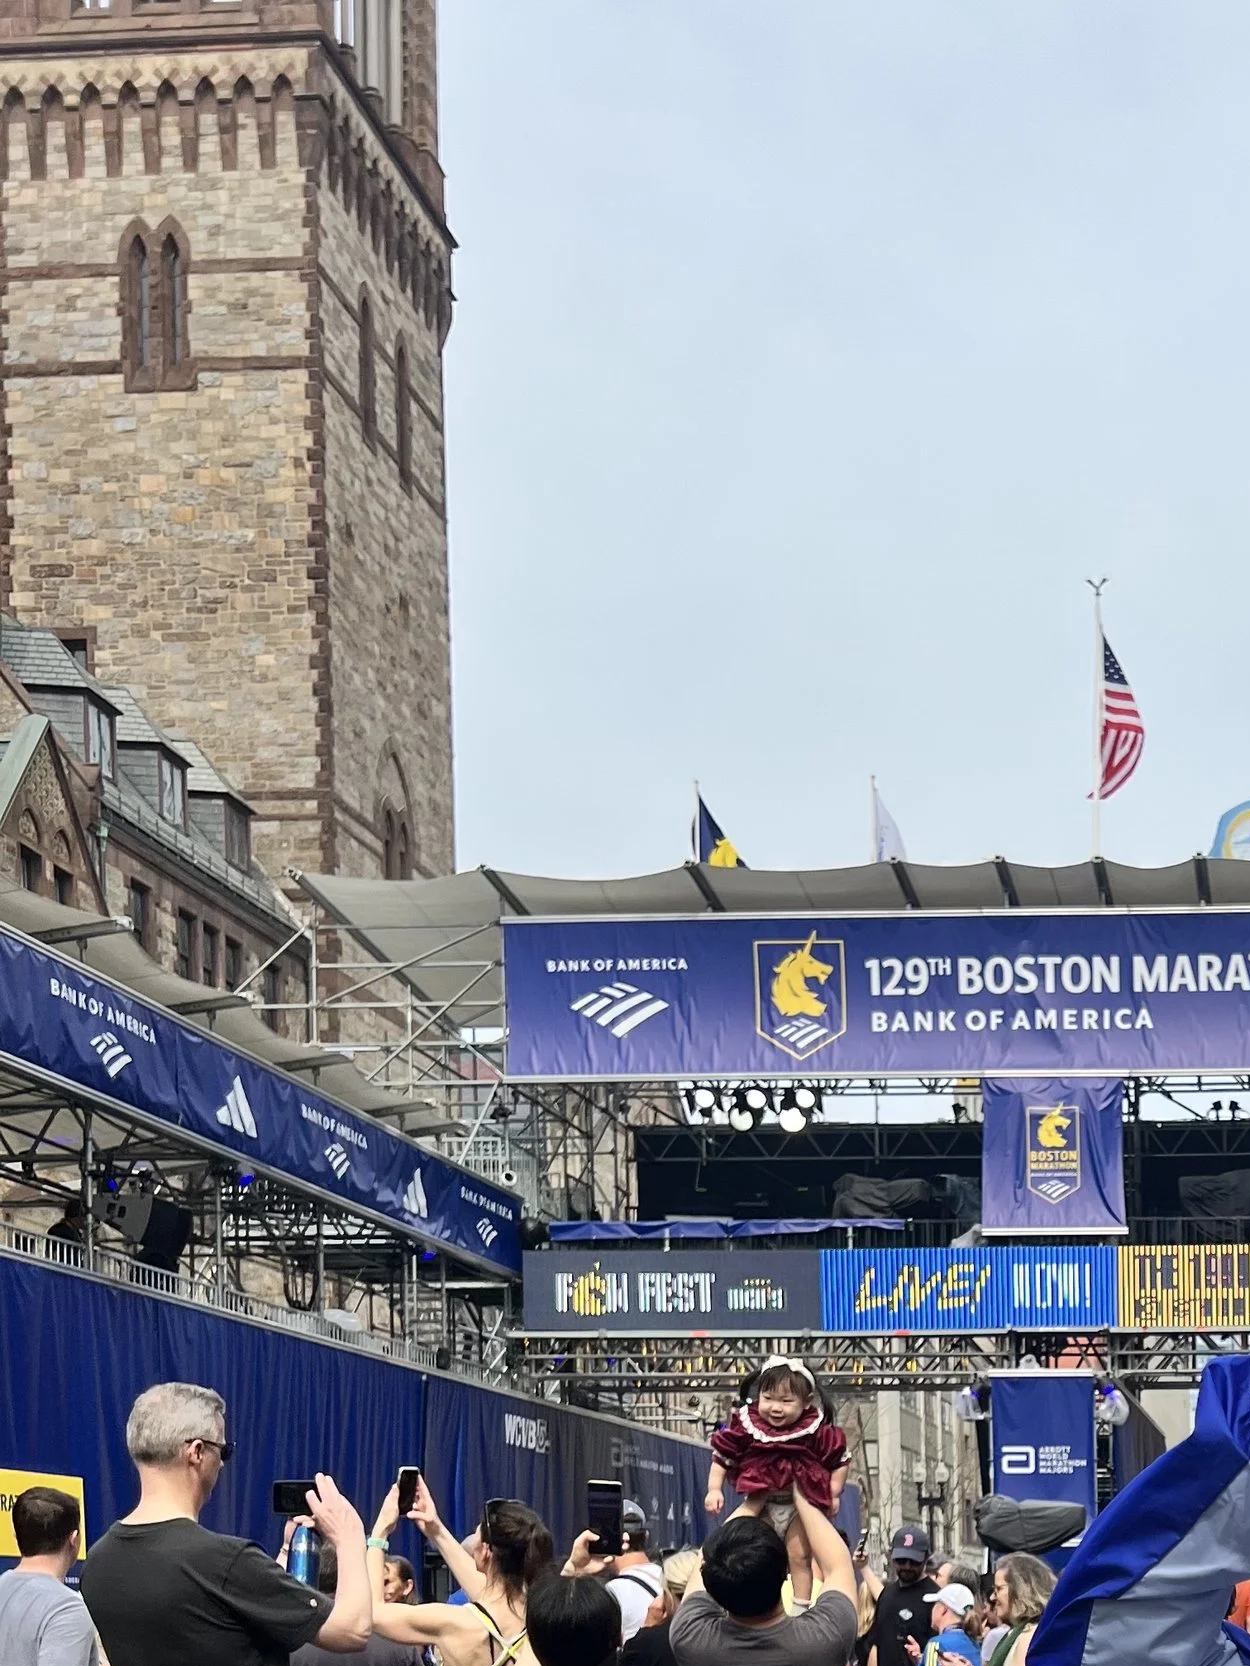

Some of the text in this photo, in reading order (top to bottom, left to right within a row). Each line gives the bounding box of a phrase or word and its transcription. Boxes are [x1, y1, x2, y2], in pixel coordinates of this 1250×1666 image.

[547, 957, 688, 973] BANK OF AMERICA
[864, 956, 951, 996] 129TH
[957, 953, 1120, 995] BOSTON
[50, 978, 156, 1045] BANK OF AMERICA
[871, 1007, 1155, 1033] BANK OF AMERICA
[323, 1116, 335, 1132] OF
[1030, 1150, 1077, 1162] BOSTON
[1030, 1162, 1077, 1170] MARATHON
[638, 1272, 715, 1313] FEST
[505, 1413, 537, 1450] WCVB
[1039, 1459, 1087, 1467] MARATHON
[1039, 1466, 1074, 1475] MAJORS
